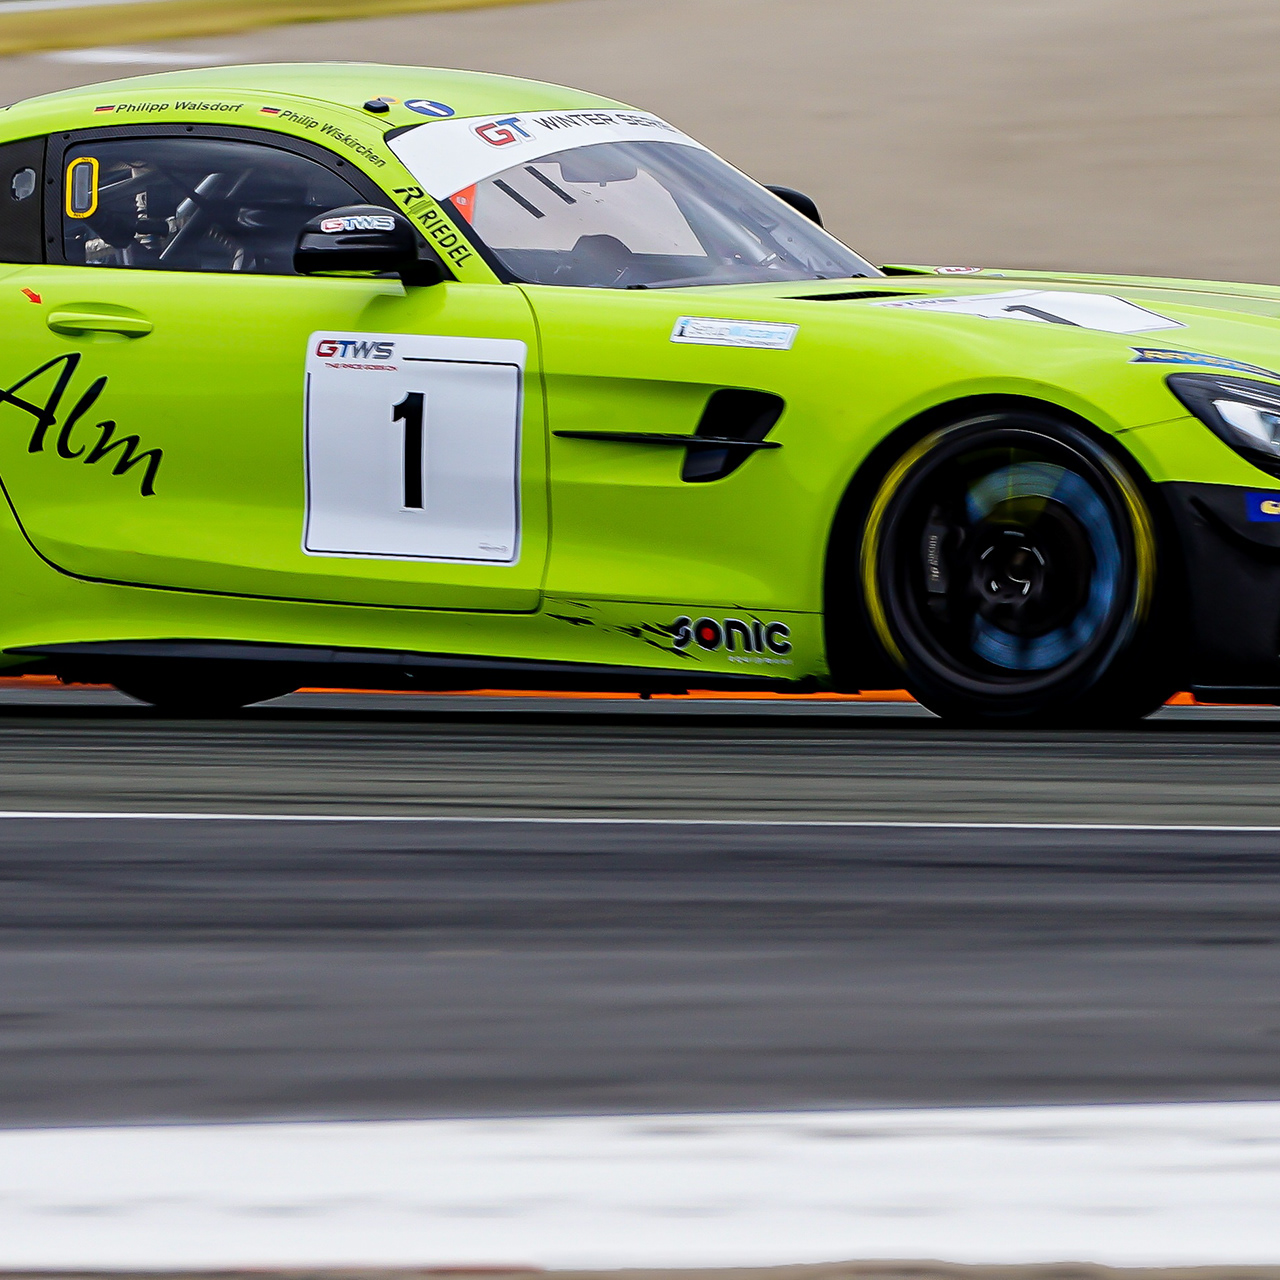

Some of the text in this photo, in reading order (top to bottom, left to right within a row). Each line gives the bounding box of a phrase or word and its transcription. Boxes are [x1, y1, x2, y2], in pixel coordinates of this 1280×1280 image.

[116, 100, 244, 114] Philipp Walsdorf
[278, 110, 319, 130] Philip
[474, 116, 532, 147] GT
[532, 113, 620, 131] WINTER
[321, 215, 395, 233] GTWS
[417, 209, 473, 268] RIEDEL
[316, 339, 395, 359] GTWS
[390, 391, 426, 510] 1
